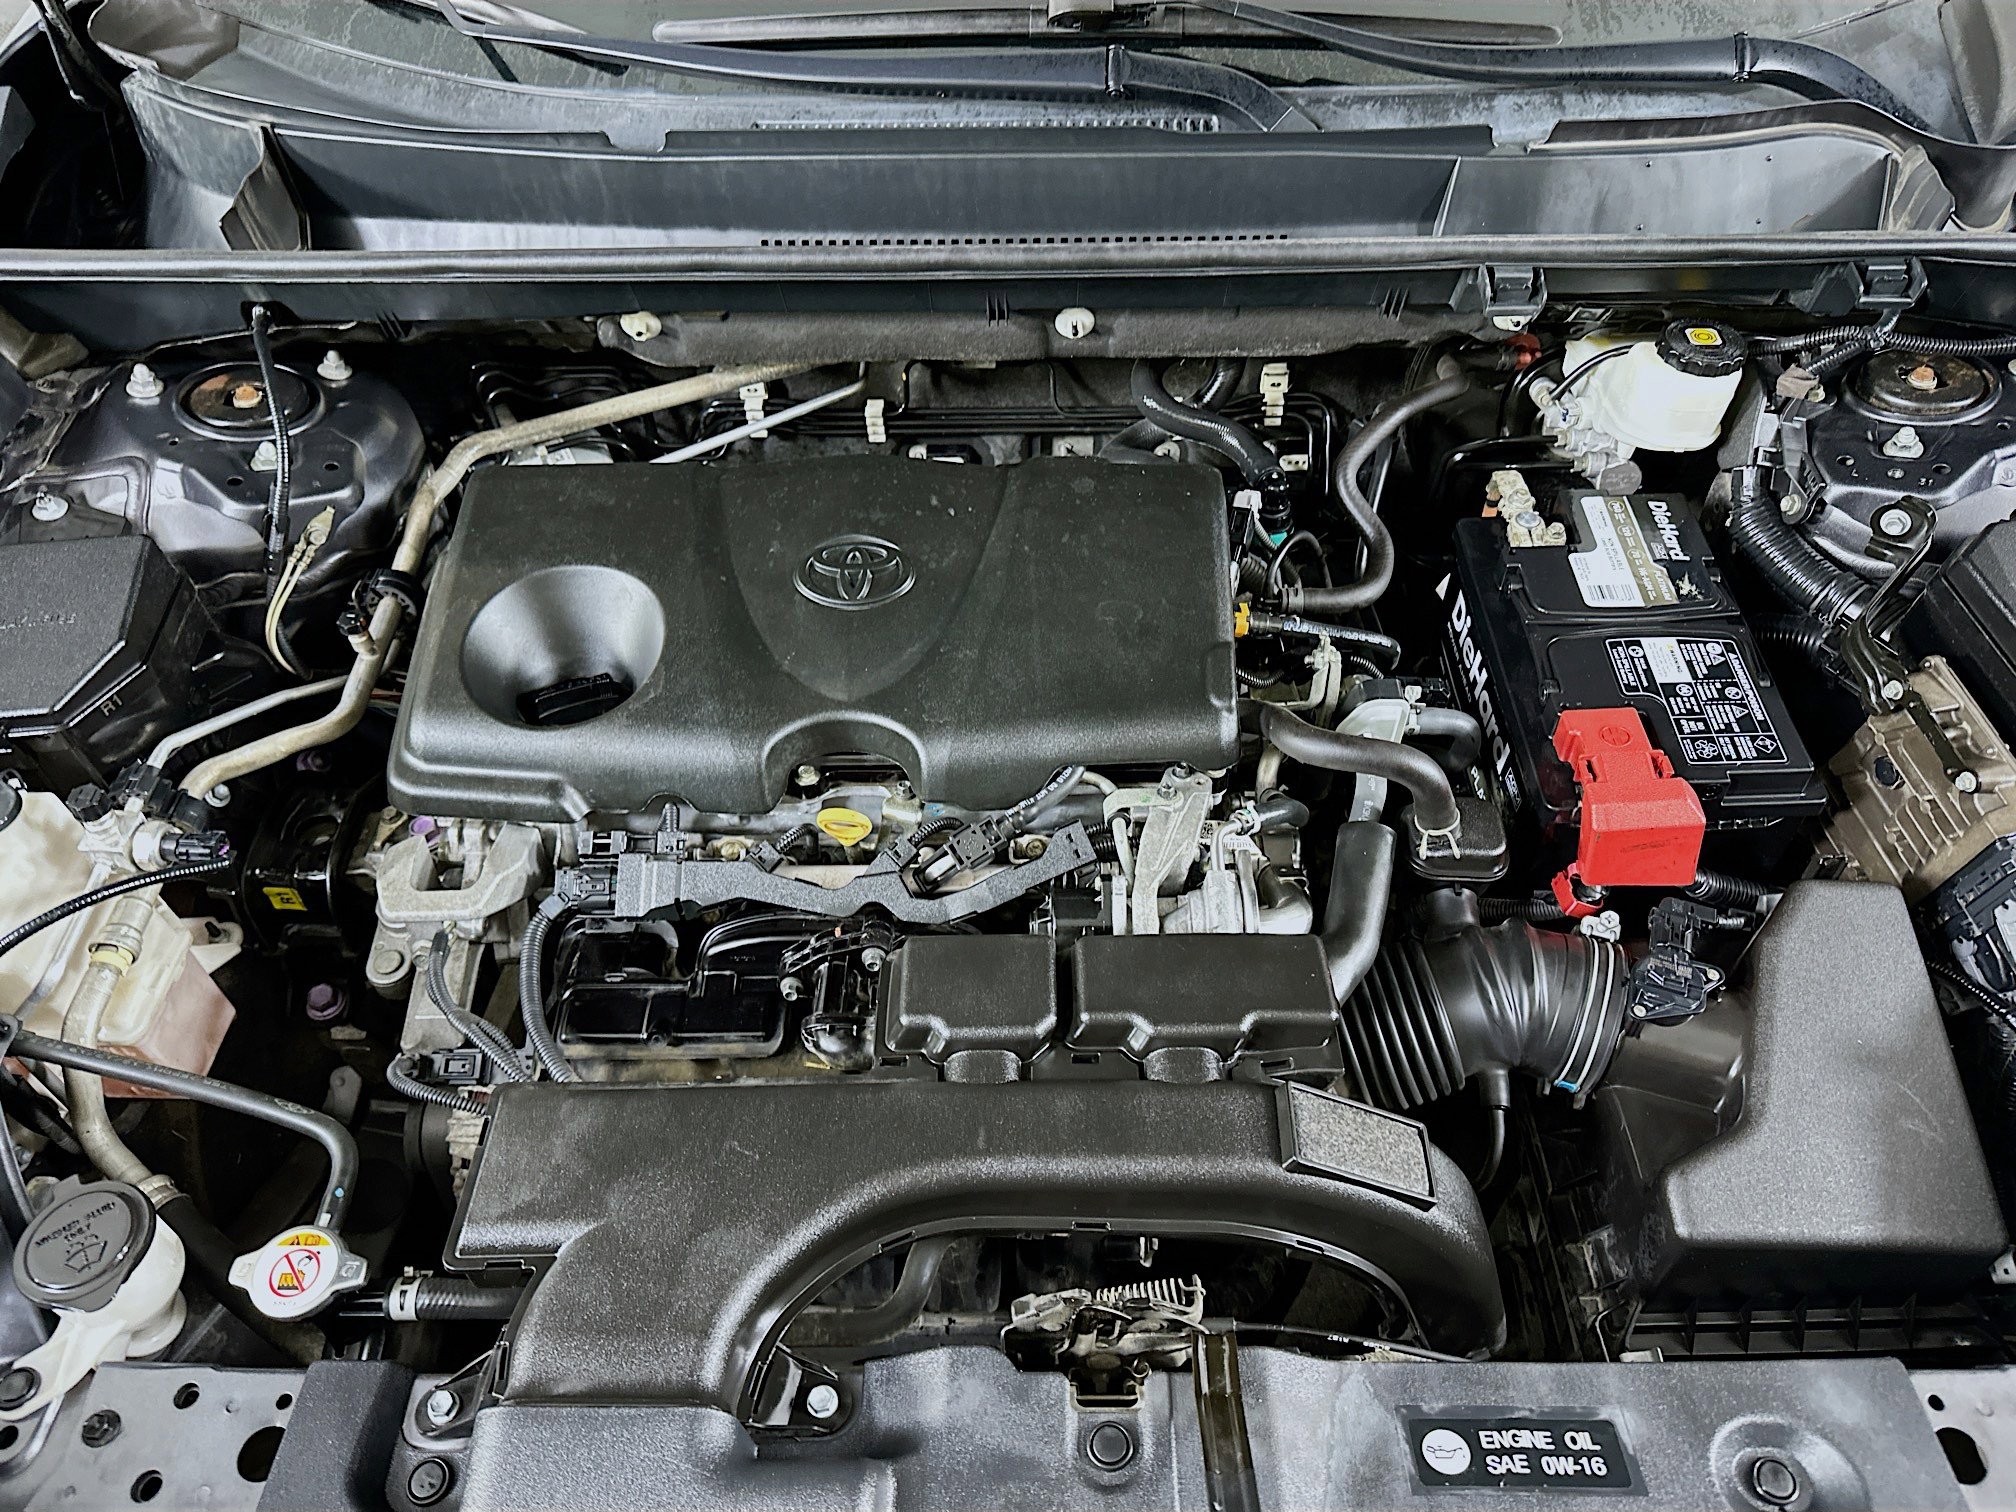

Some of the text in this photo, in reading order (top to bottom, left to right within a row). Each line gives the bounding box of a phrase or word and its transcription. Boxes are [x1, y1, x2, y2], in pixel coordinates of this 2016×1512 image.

[1647, 500, 1690, 562] DieHard
[1654, 570, 1673, 601] PLATINUM
[1452, 588, 1510, 775] DieHard
[100, 693, 122, 716] R1
[1478, 1429, 1602, 1451] ENGINE OIL
[1485, 1454, 1608, 1477] SAE 0W-16
